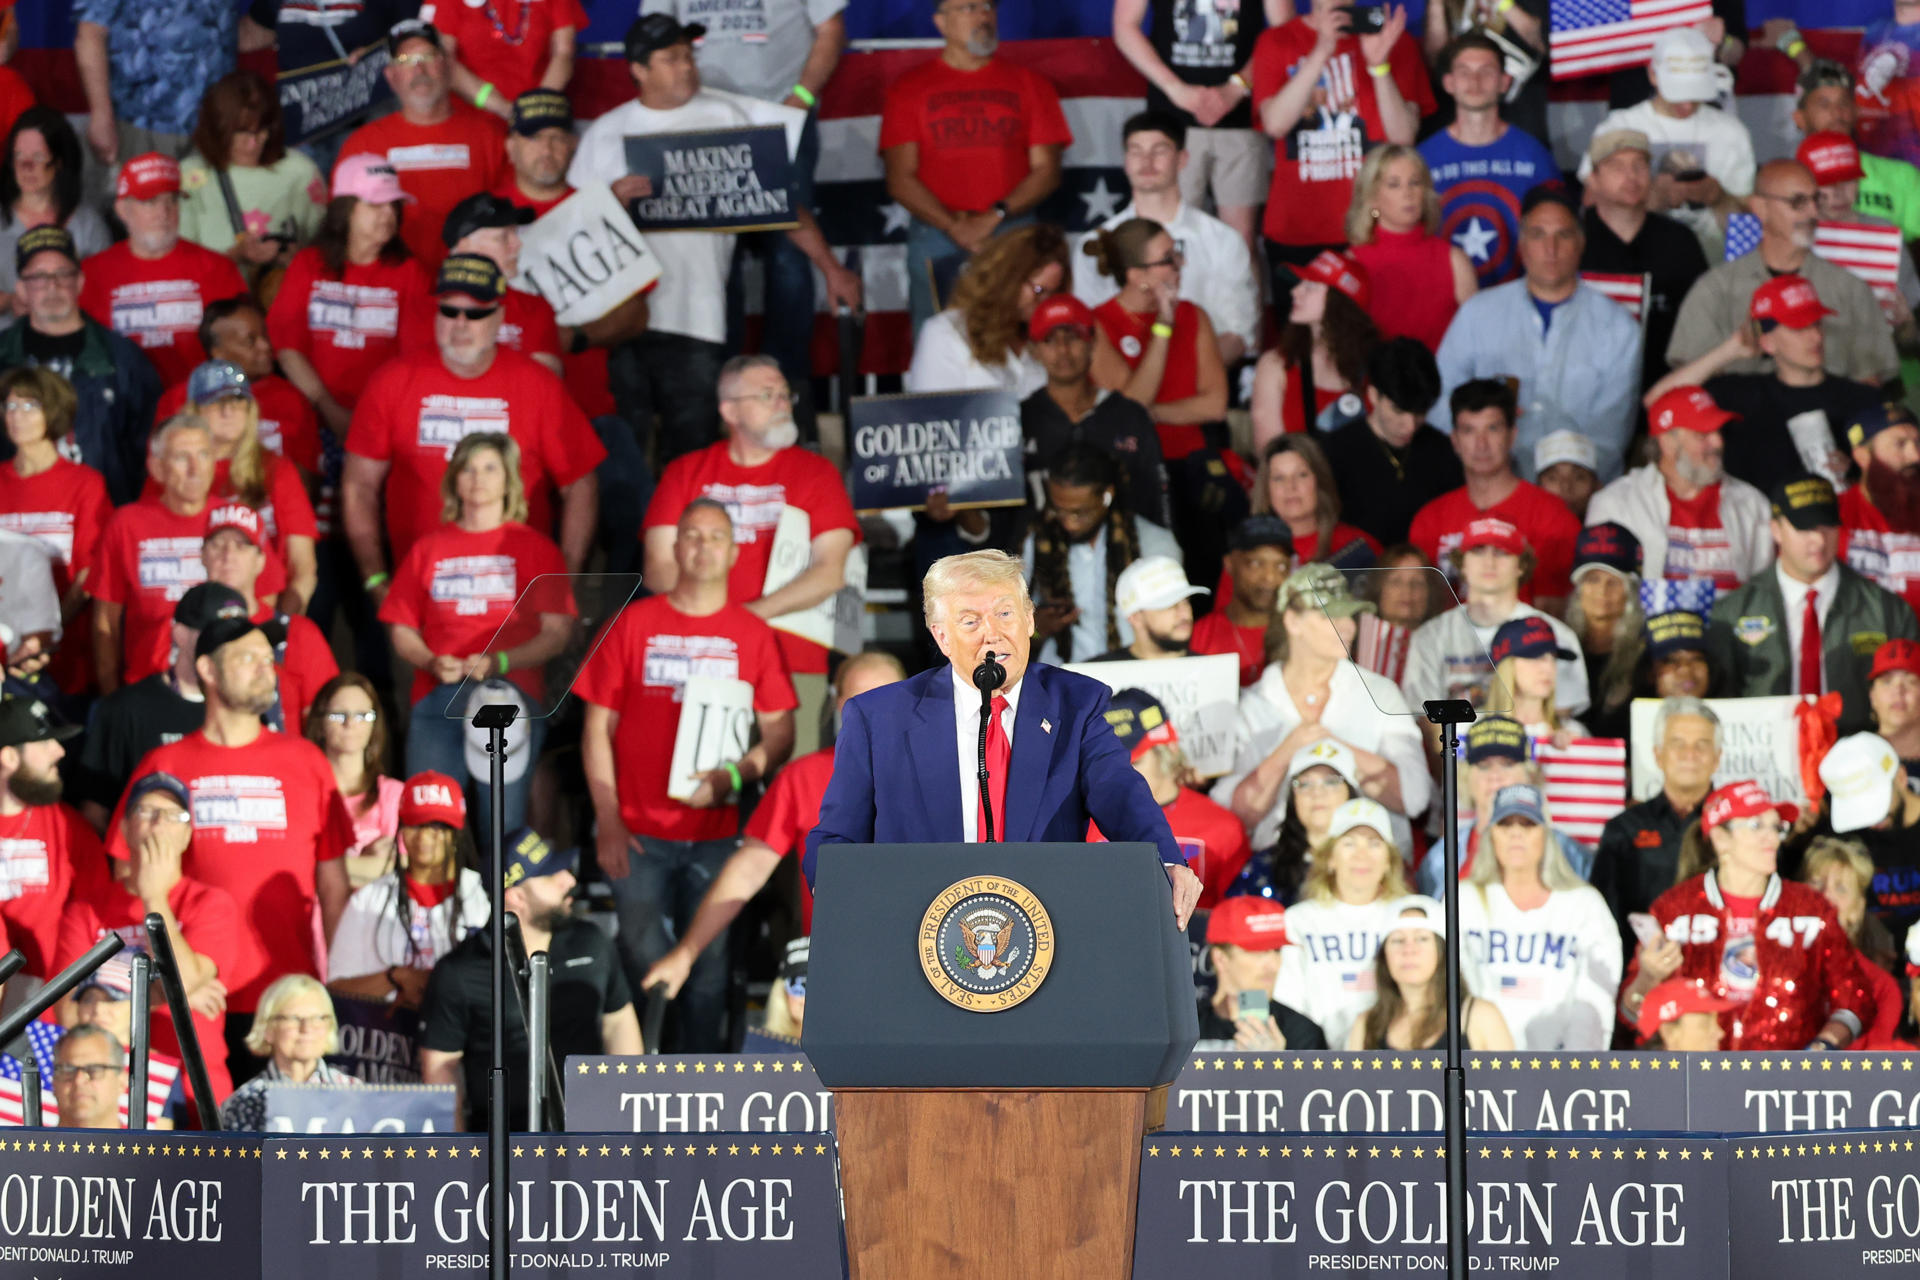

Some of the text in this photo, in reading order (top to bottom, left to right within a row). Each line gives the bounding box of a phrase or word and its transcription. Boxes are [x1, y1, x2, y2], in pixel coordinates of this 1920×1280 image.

[663, 143, 752, 171] MAKING
[662, 169, 763, 197] AMERICA
[638, 196, 711, 221] GREAT
[524, 213, 644, 314] AGA
[855, 415, 1021, 459] GOLDEN AGE
[864, 451, 1013, 486] OF AMERICA
[412, 784, 453, 807] USA
[923, 879, 1051, 1006] SEAL OF THE PRESIDENT OF THE UNITED STATES
[1665, 913, 1719, 945] 45
[1764, 916, 1822, 950] 47
[338, 1023, 414, 1068] OLDEN
[620, 1091, 725, 1132] THE
[1178, 1088, 1285, 1132] THE
[1536, 1087, 1632, 1132] AGE
[1744, 1088, 1853, 1132] THE
[0, 1172, 223, 1243] OLDEN AGE
[301, 1180, 417, 1245] THE
[682, 1177, 794, 1243] AGE
[1178, 1179, 1298, 1244] THE
[1569, 1181, 1686, 1247] AGE
[1770, 1177, 1857, 1243] THE
[30, 1247, 81, 1263] DONALD
[81, 1249, 90, 1264] J.
[91, 1249, 135, 1265] TRUMP
[425, 1252, 670, 1269] PRESIDET DONALD J. TRUMP
[1308, 1254, 1560, 1271] PRESIDENT DOND J. TRUMP
